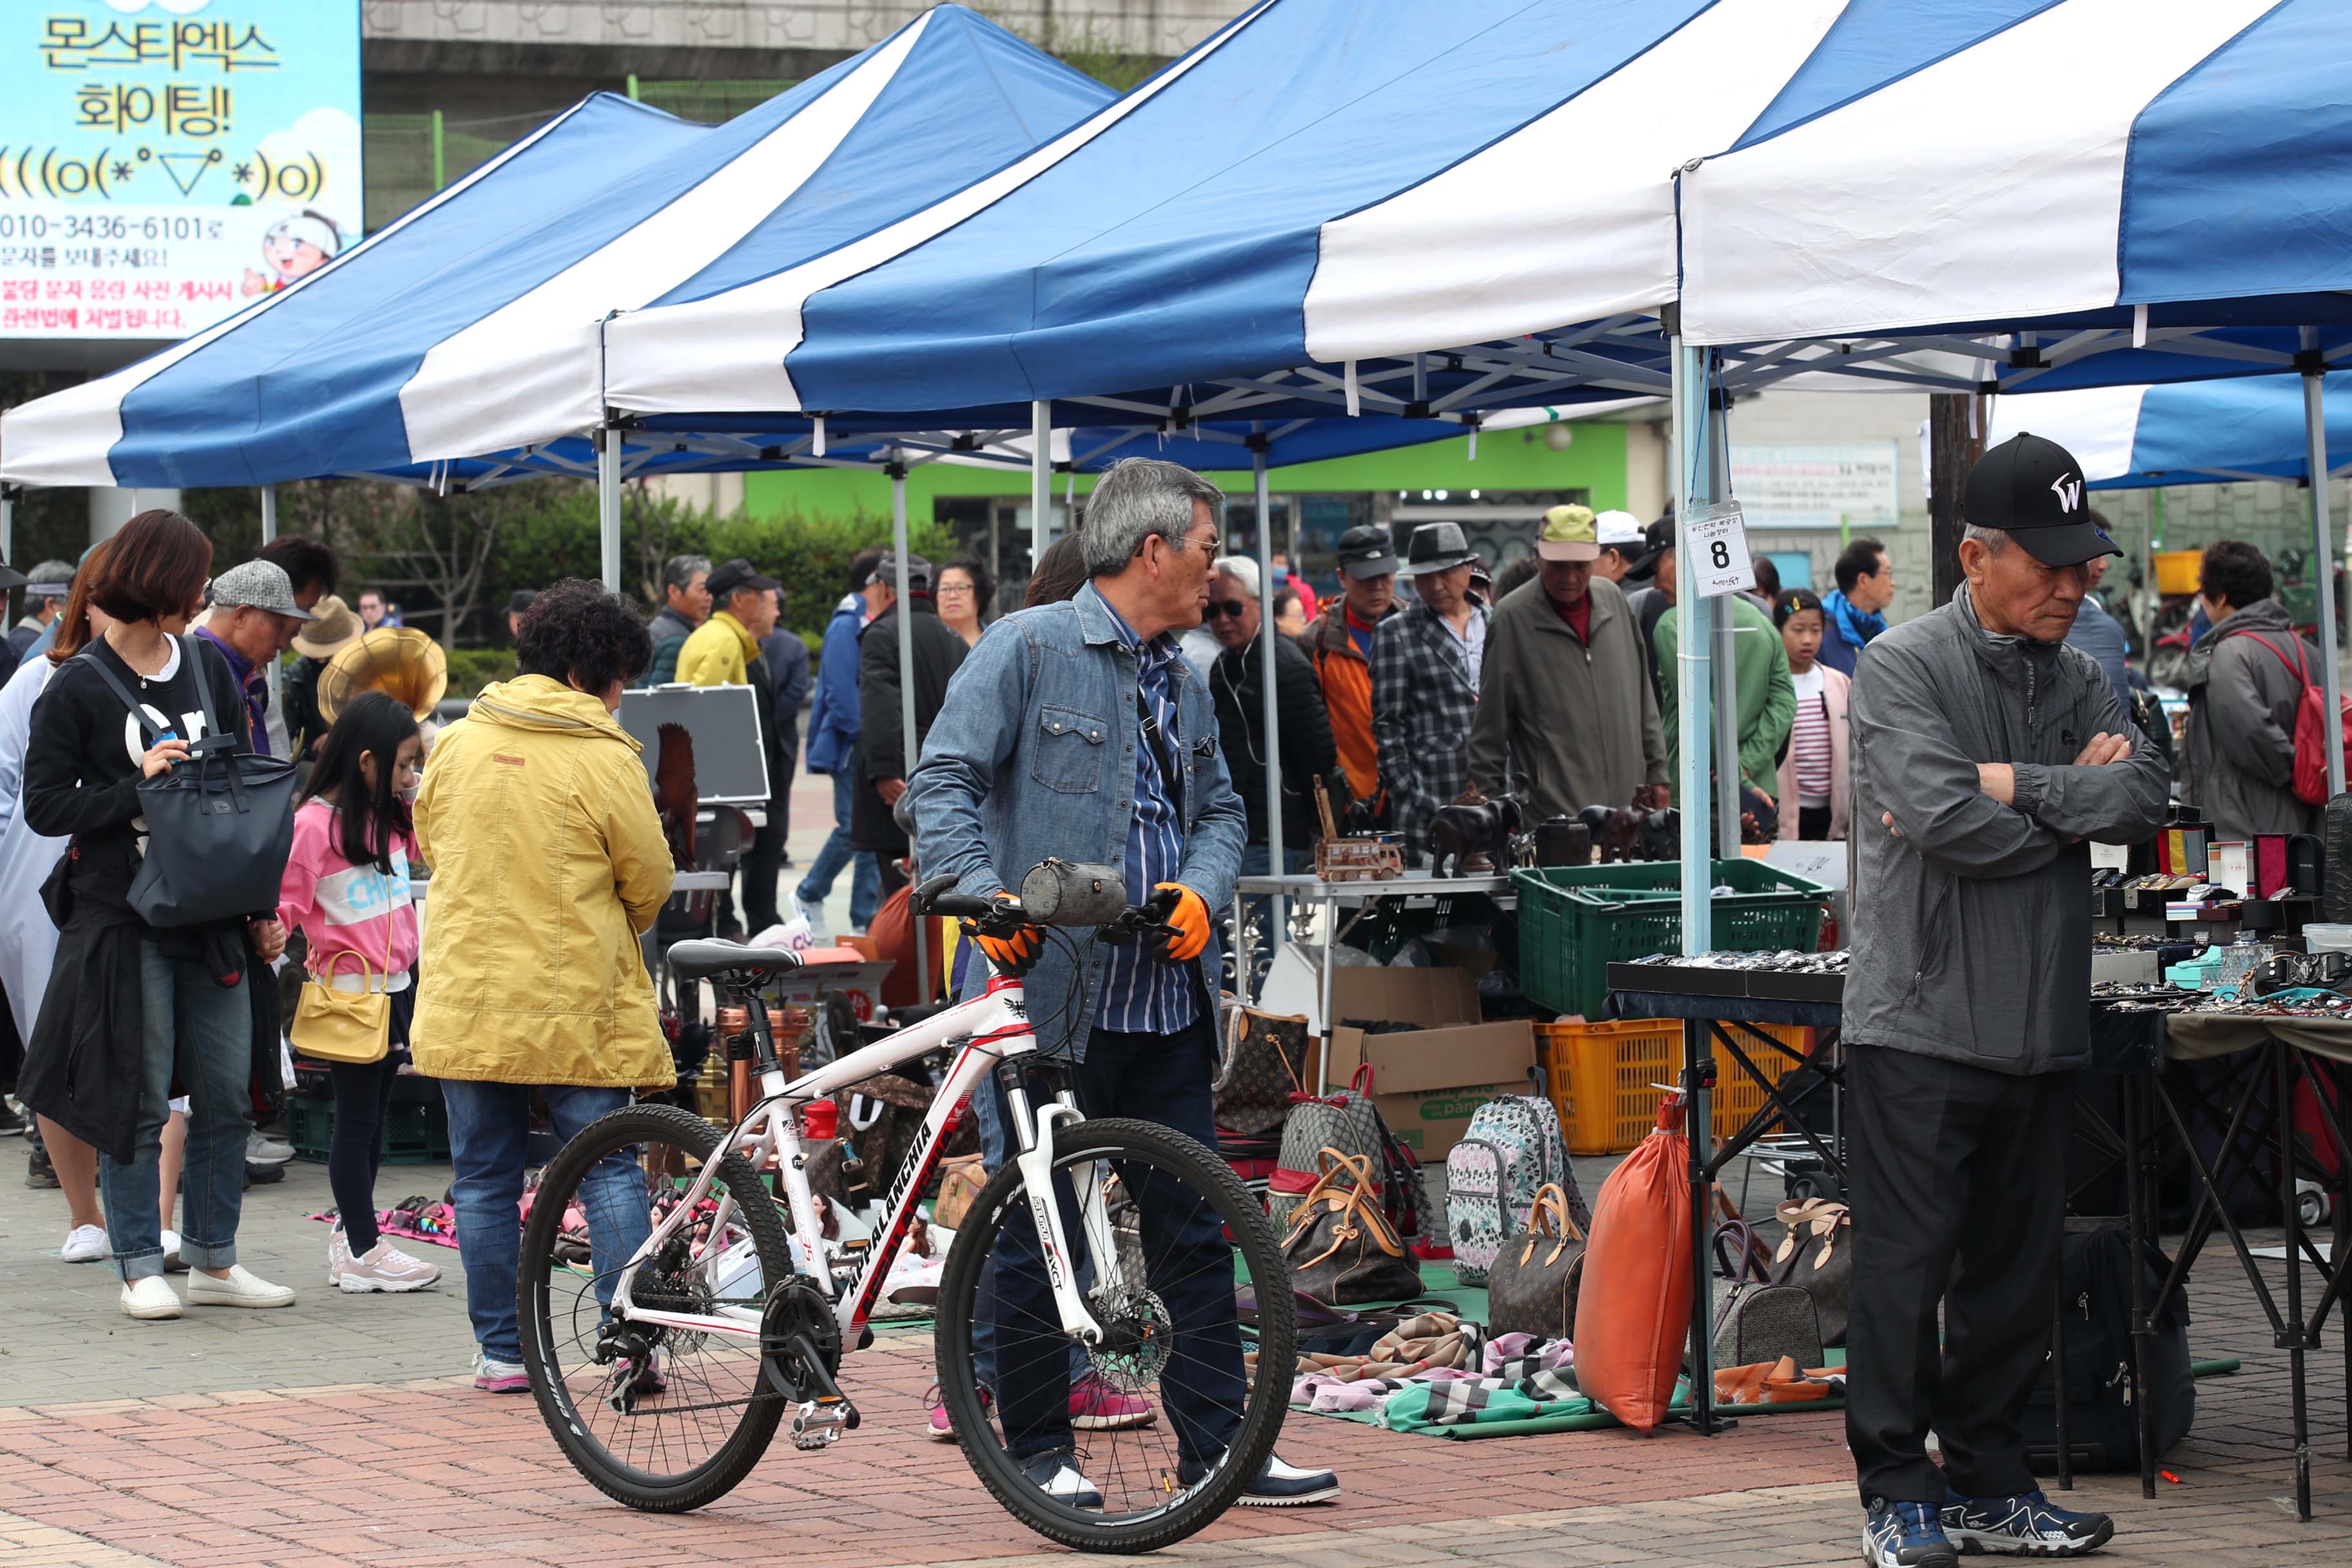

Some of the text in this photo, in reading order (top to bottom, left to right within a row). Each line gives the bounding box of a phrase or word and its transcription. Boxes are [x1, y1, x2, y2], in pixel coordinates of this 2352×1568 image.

[39, 19, 280, 72] 몬스타엑스
[75, 83, 231, 137] 화이팅!
[2, 247, 167, 269] 문자를 보내주세요!
[132, 279, 170, 301] 사진
[1710, 540, 1730, 569] 8
[849, 1120, 932, 1298] APPALANCHIA
